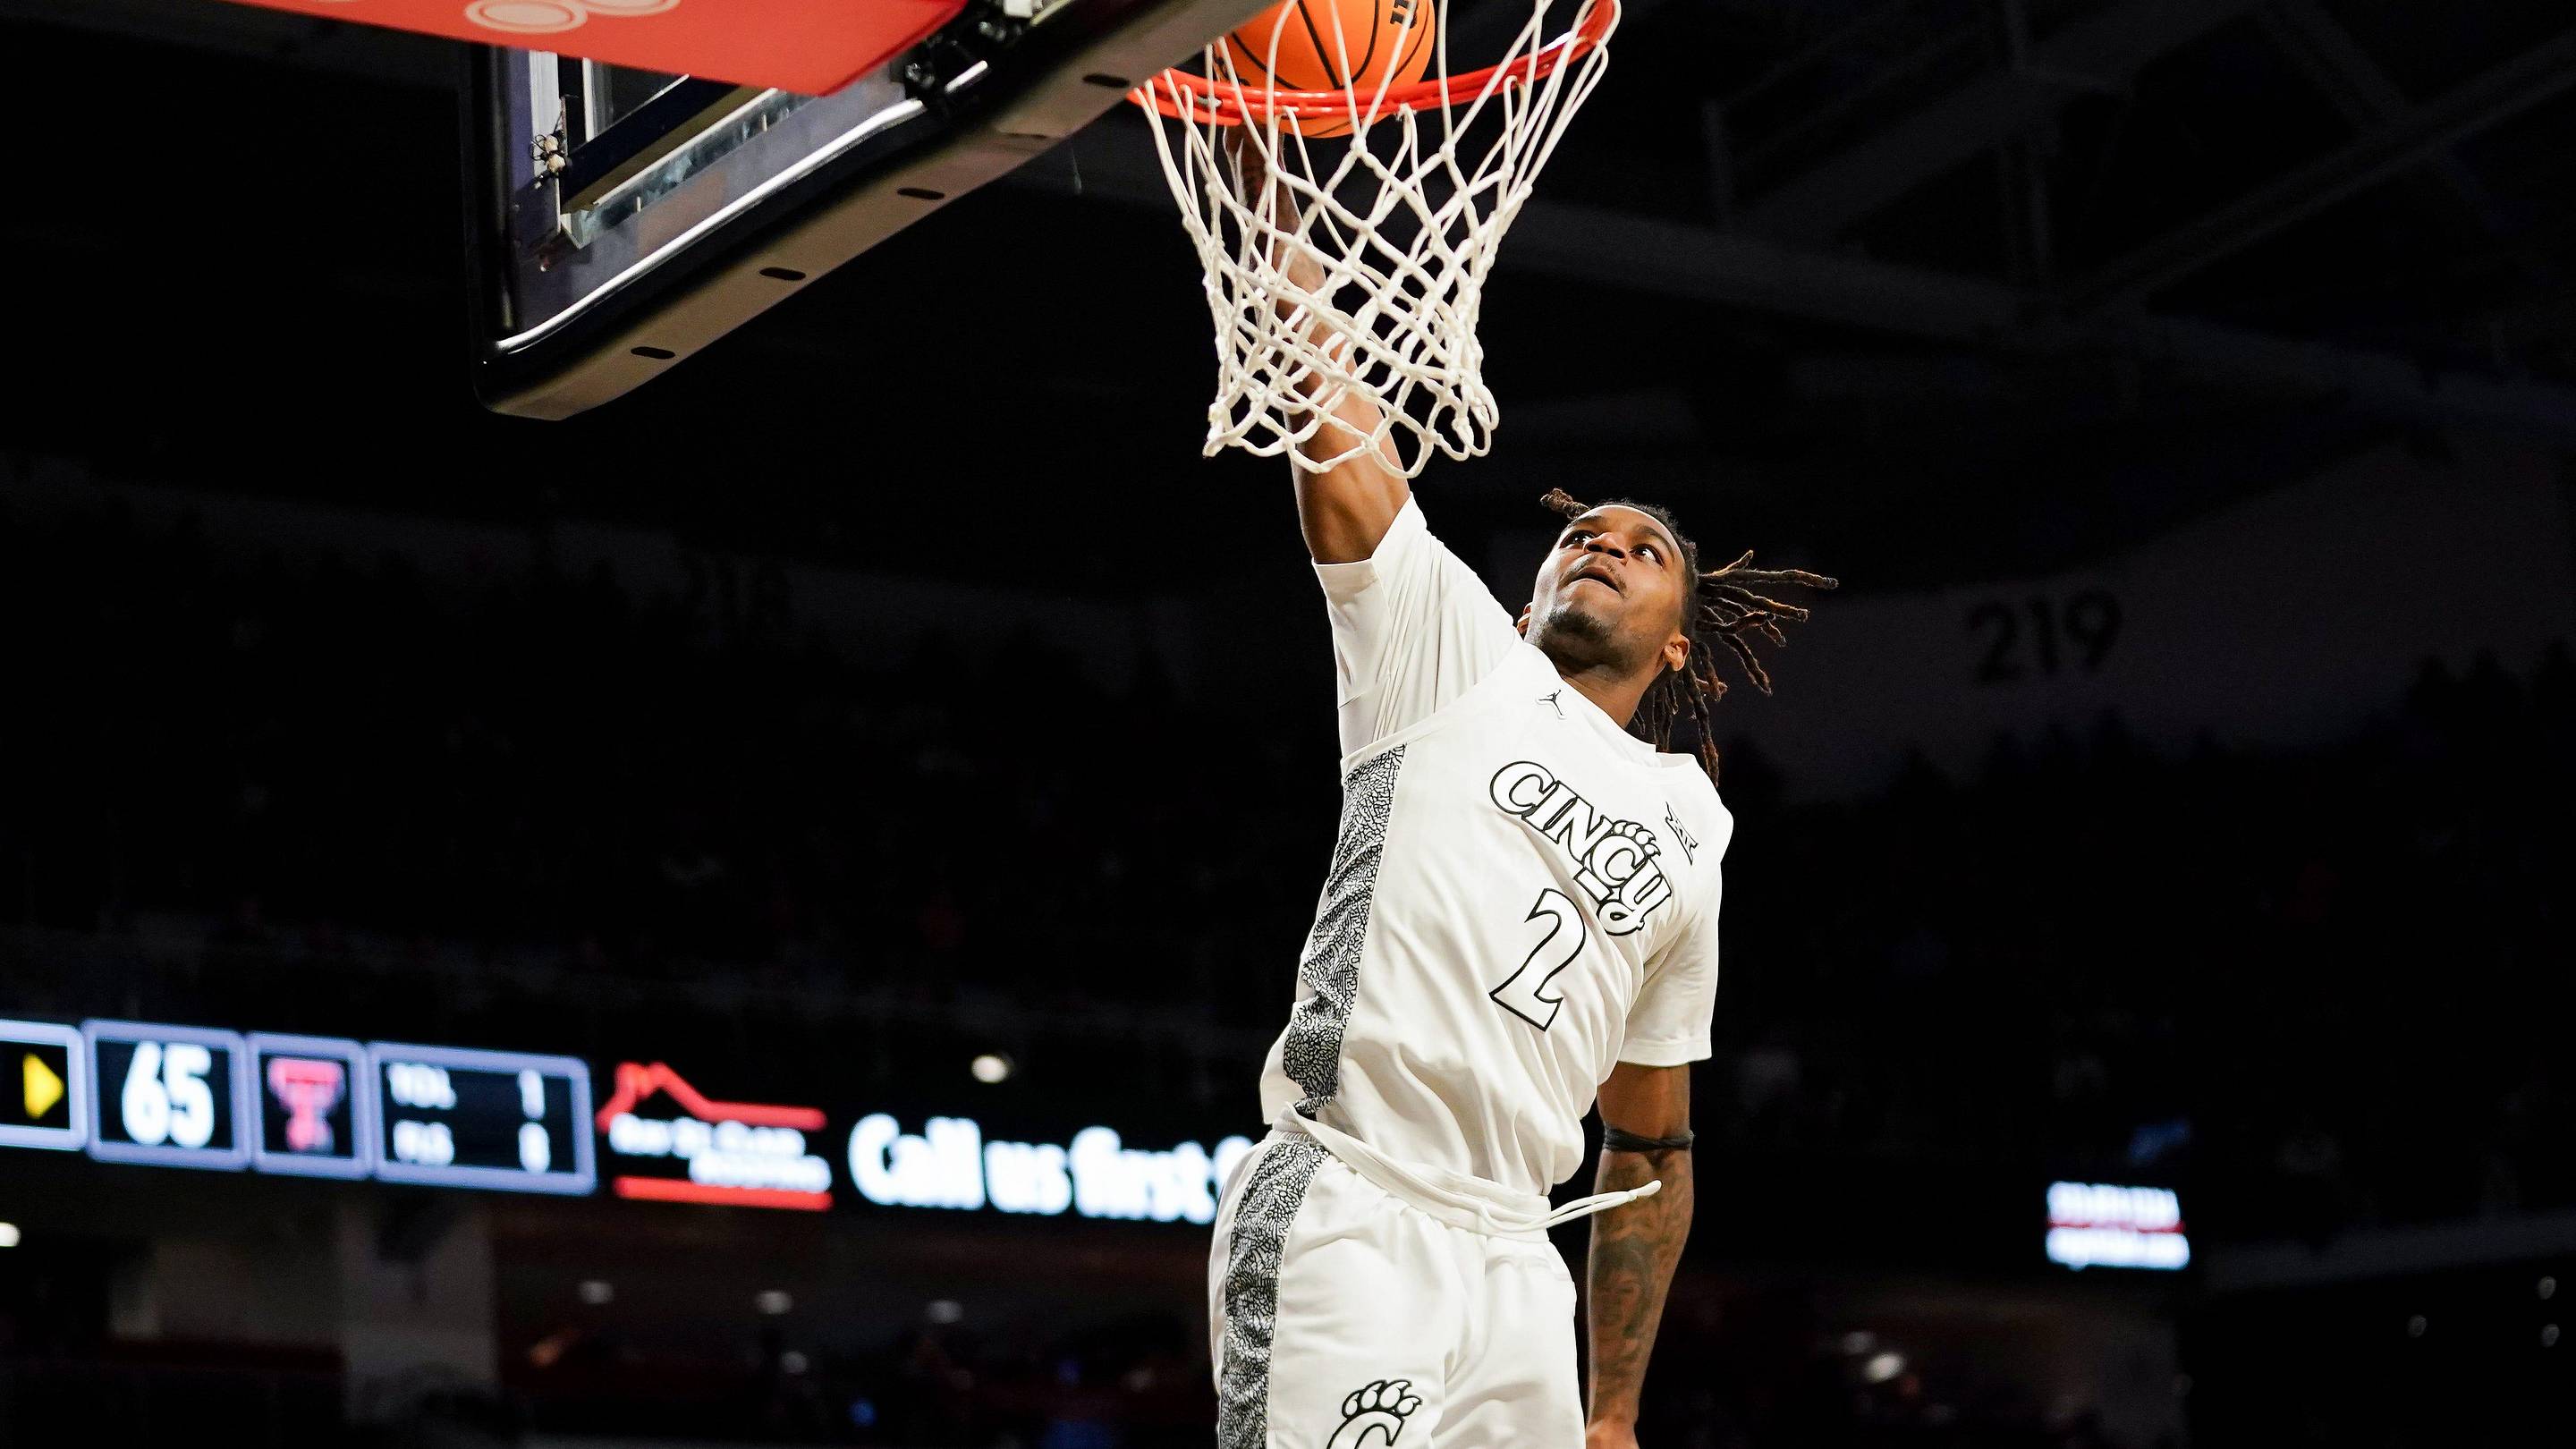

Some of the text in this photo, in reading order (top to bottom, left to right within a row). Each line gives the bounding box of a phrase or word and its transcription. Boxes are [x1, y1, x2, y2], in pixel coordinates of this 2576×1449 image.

[1966, 588, 2123, 682] 219
[1489, 887, 1587, 1032] 2
[122, 1039, 216, 1147] 65
[849, 1114, 982, 1209] Call
[985, 1140, 1072, 1215] us
[1070, 1127, 1217, 1224] first
